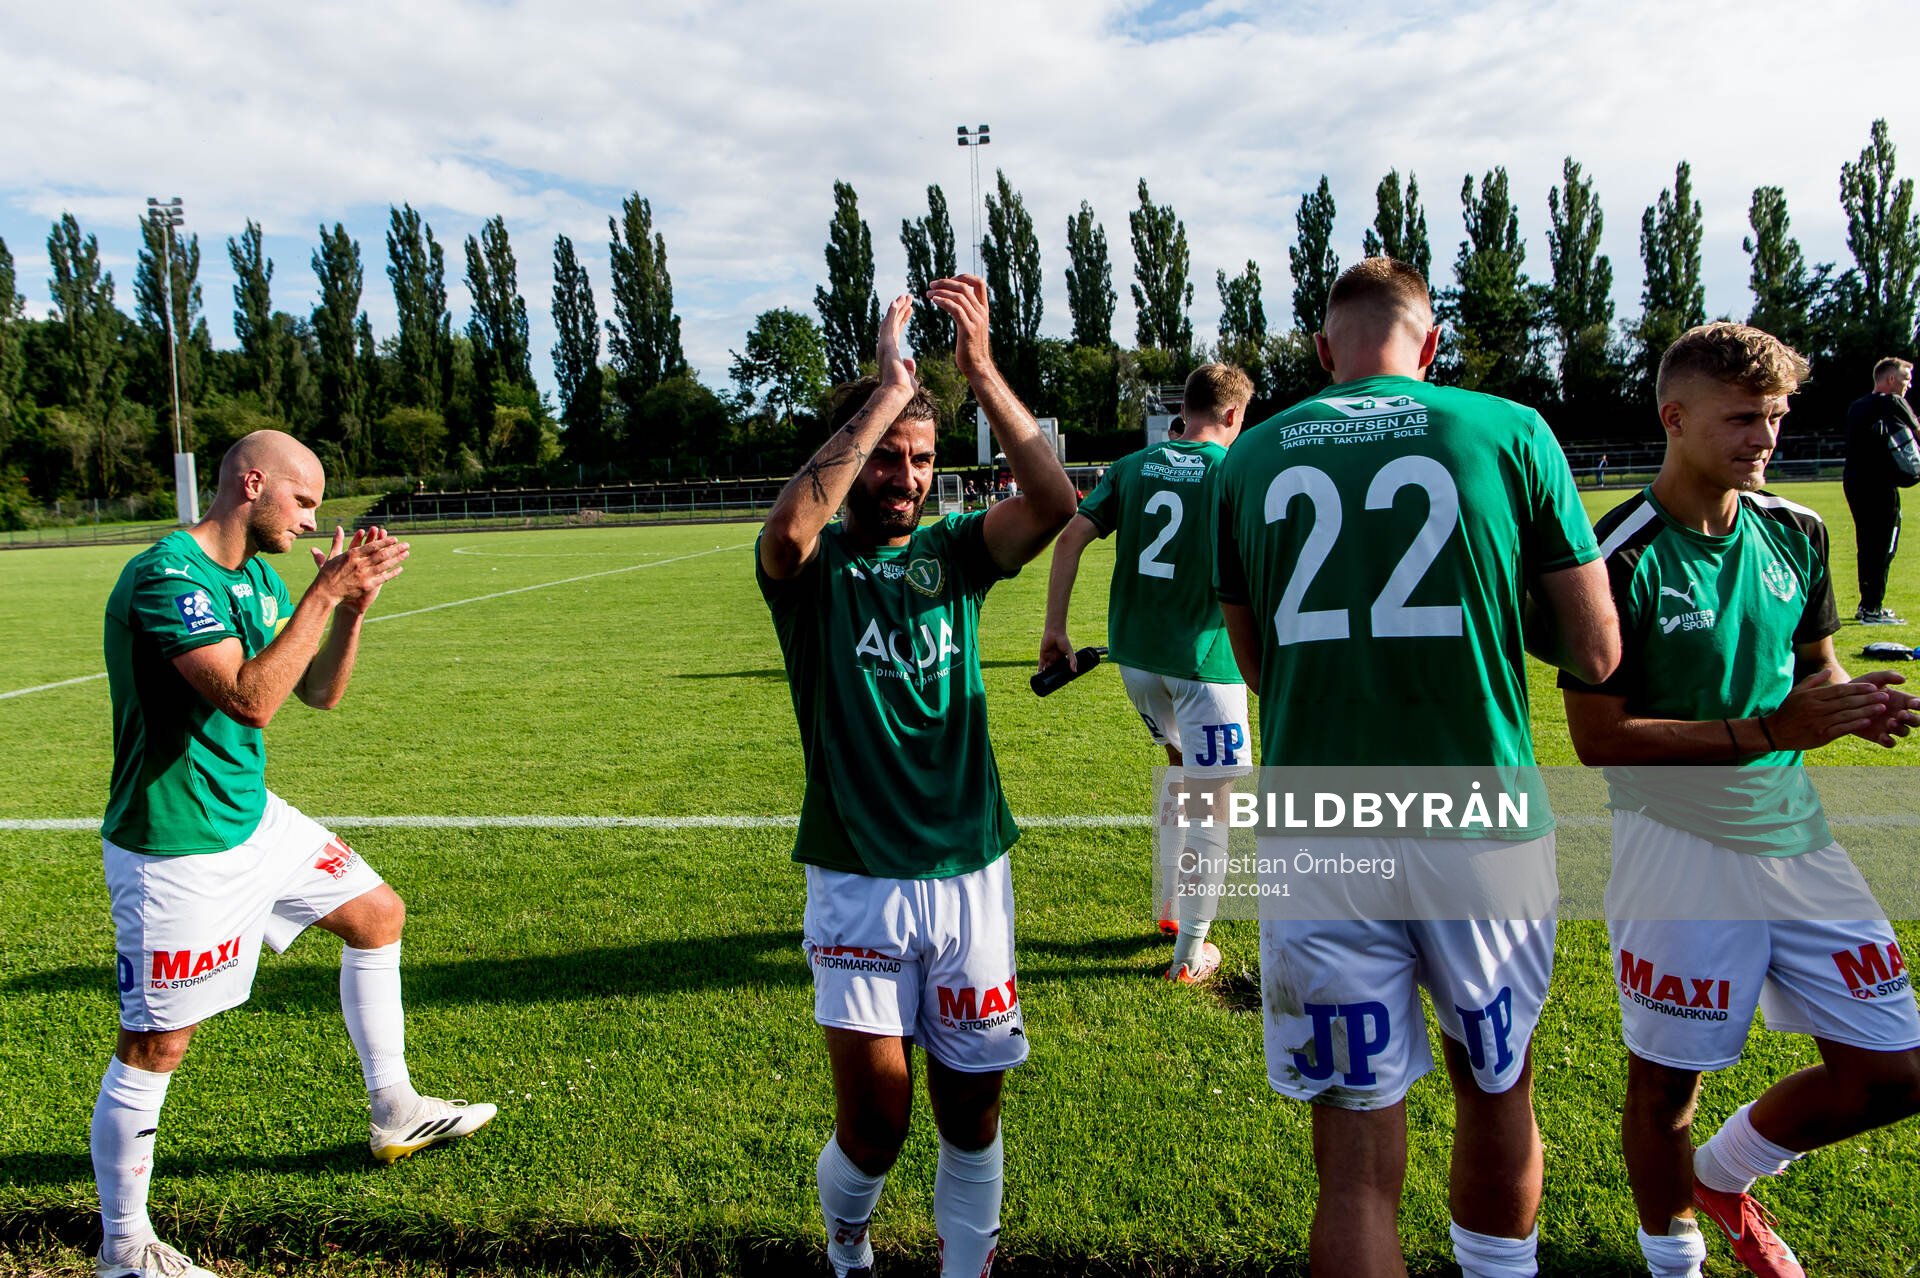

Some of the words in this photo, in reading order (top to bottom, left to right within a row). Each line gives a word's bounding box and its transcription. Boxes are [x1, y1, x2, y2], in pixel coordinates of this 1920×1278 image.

[1280, 416, 1399, 440] TAKPROFFSEN
[1403, 413, 1428, 426] AB
[1281, 437, 1325, 450] TAKBYTE
[1333, 433, 1387, 445] TAKTVÄTT
[1394, 428, 1428, 439] SOLEL
[1138, 490, 1183, 580] 2
[1264, 455, 1463, 646] 22
[1681, 609, 1714, 622] INTER
[1682, 618, 1715, 632] SPORT
[856, 617, 961, 674] AQUA
[876, 667, 910, 681] DINNE
[1195, 723, 1244, 767] JP
[151, 980, 168, 990] ICA
[171, 958, 239, 990] STORMARKNAD
[152, 935, 241, 980] MAXI
[821, 955, 901, 974] STORMARKNAD
[1620, 949, 1730, 1010] MAXI
[1832, 942, 1905, 990] MA
[937, 974, 1018, 1020] MAX
[960, 1006, 1018, 1031] STORMARK
[1634, 993, 1729, 1021] STORMARKNAD
[1293, 1001, 1391, 1086] JP
[1455, 986, 1514, 1076] JP
